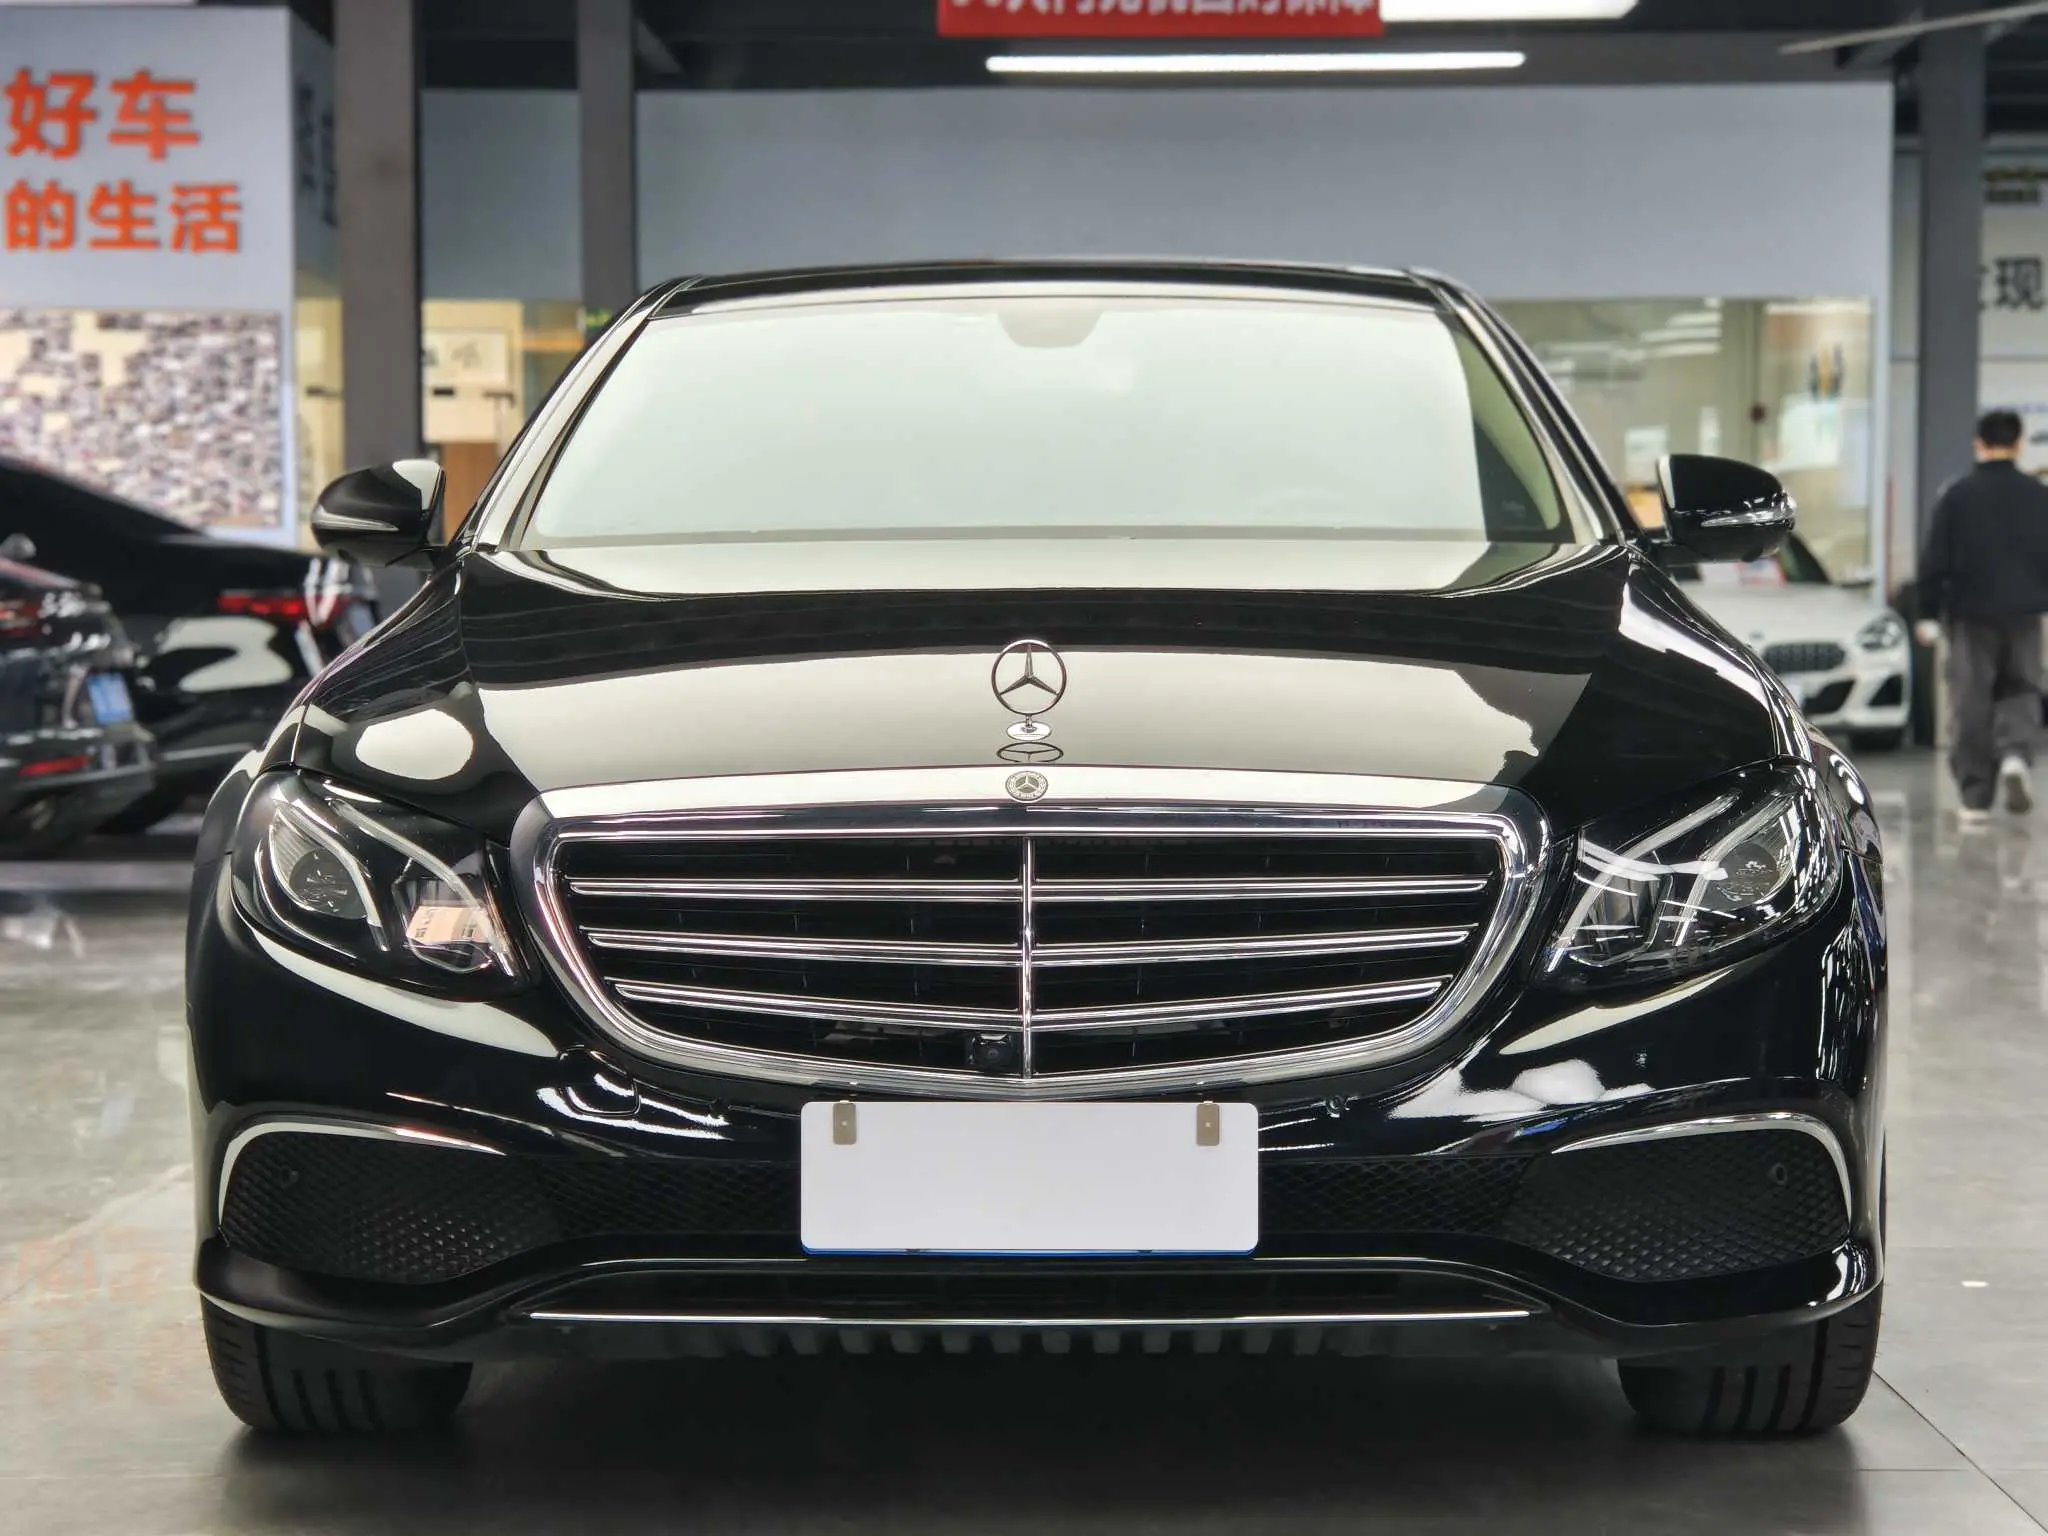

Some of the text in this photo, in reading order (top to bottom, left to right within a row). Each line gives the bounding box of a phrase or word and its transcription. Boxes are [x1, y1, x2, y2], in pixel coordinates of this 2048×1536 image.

[5, 67, 201, 160] 好车
[5, 179, 241, 253] 的生活
[1978, 256, 2044, 311] 现
